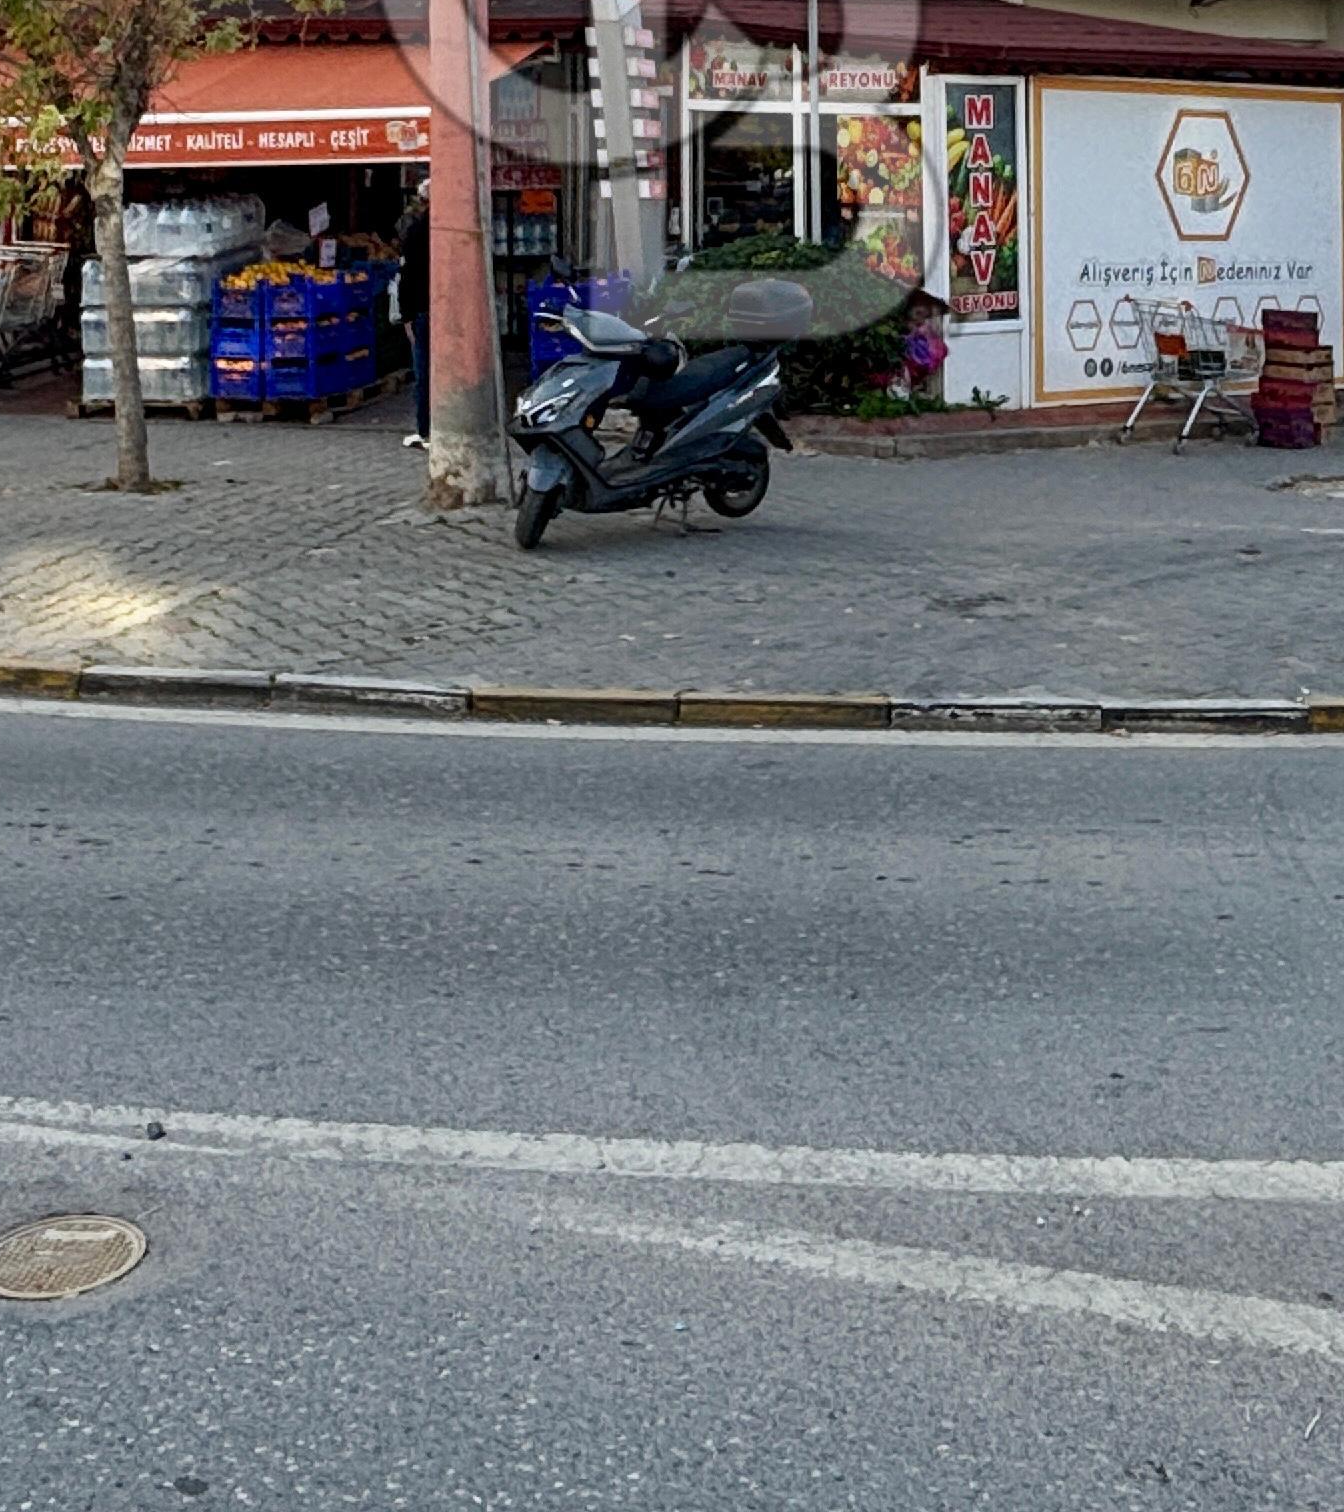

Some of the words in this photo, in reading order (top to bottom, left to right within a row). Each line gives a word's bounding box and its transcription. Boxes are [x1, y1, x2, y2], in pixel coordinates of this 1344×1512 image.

[713, 72, 768, 87] MANAV
[828, 71, 894, 88] REYONU
[186, 128, 244, 151] KALİTELİ
[258, 129, 316, 150] HESAPLI
[330, 126, 370, 153] ÇEŞİT
[1286, 261, 1313, 279] Var
[952, 291, 1018, 314] REYONU
